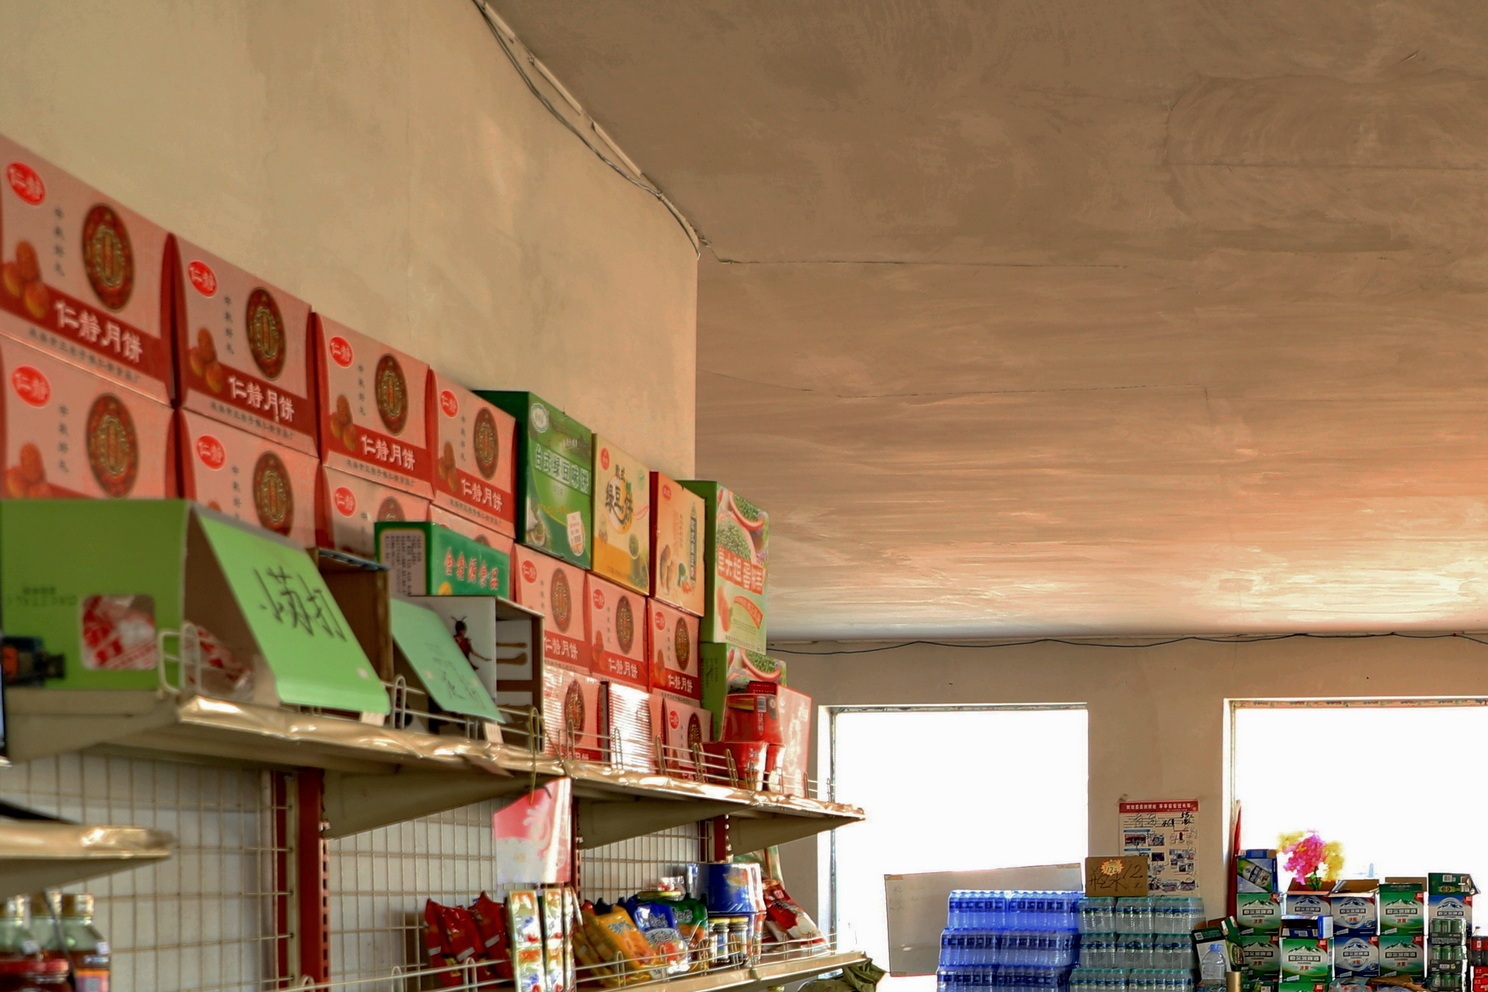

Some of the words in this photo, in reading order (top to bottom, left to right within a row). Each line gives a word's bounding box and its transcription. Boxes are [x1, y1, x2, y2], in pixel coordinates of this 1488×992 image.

[55, 301, 144, 363] 仁静月饼
[228, 376, 295, 423] 仁静月饼
[361, 435, 416, 472] 仁静月饼
[461, 478, 503, 512] 仁静月饼
[608, 657, 638, 679] 仁静月饼
[667, 674, 693, 694] 仁静月饼
